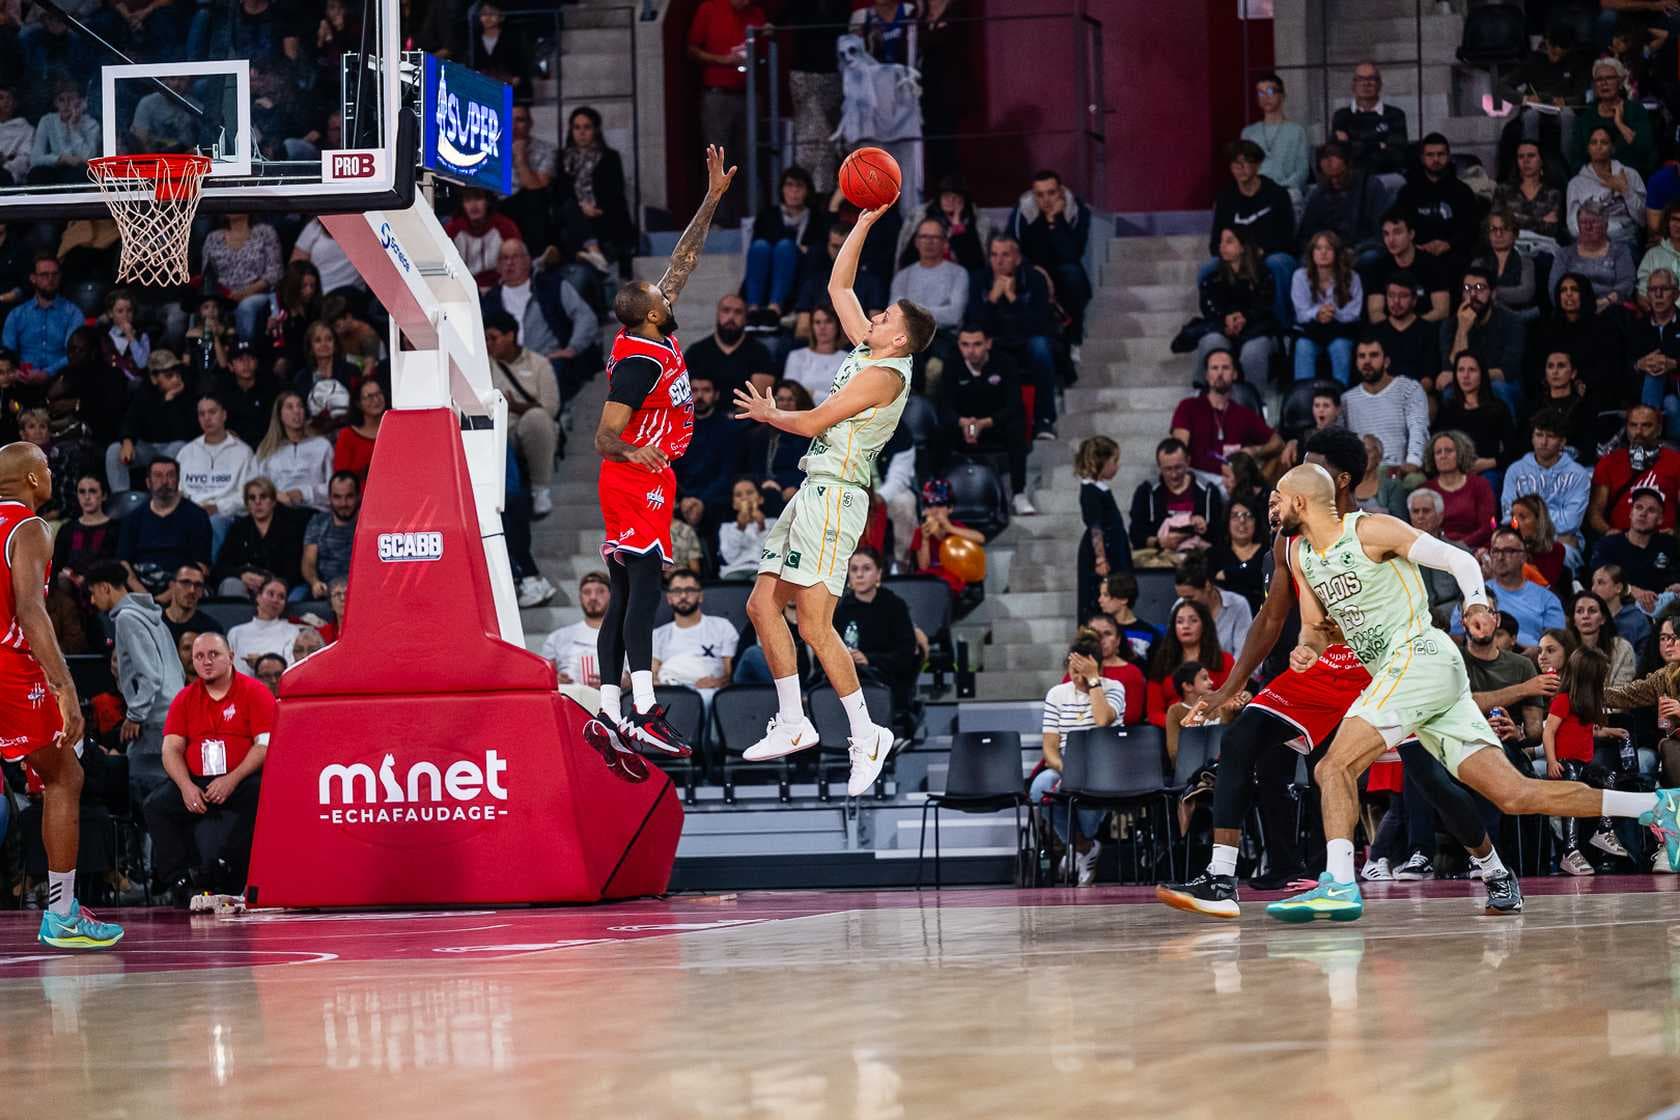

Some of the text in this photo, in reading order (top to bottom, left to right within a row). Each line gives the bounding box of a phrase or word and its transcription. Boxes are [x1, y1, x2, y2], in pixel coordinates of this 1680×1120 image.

[447, 92, 499, 158] SUPER
[380, 533, 442, 557] SCABB
[1412, 640, 1439, 656] 20
